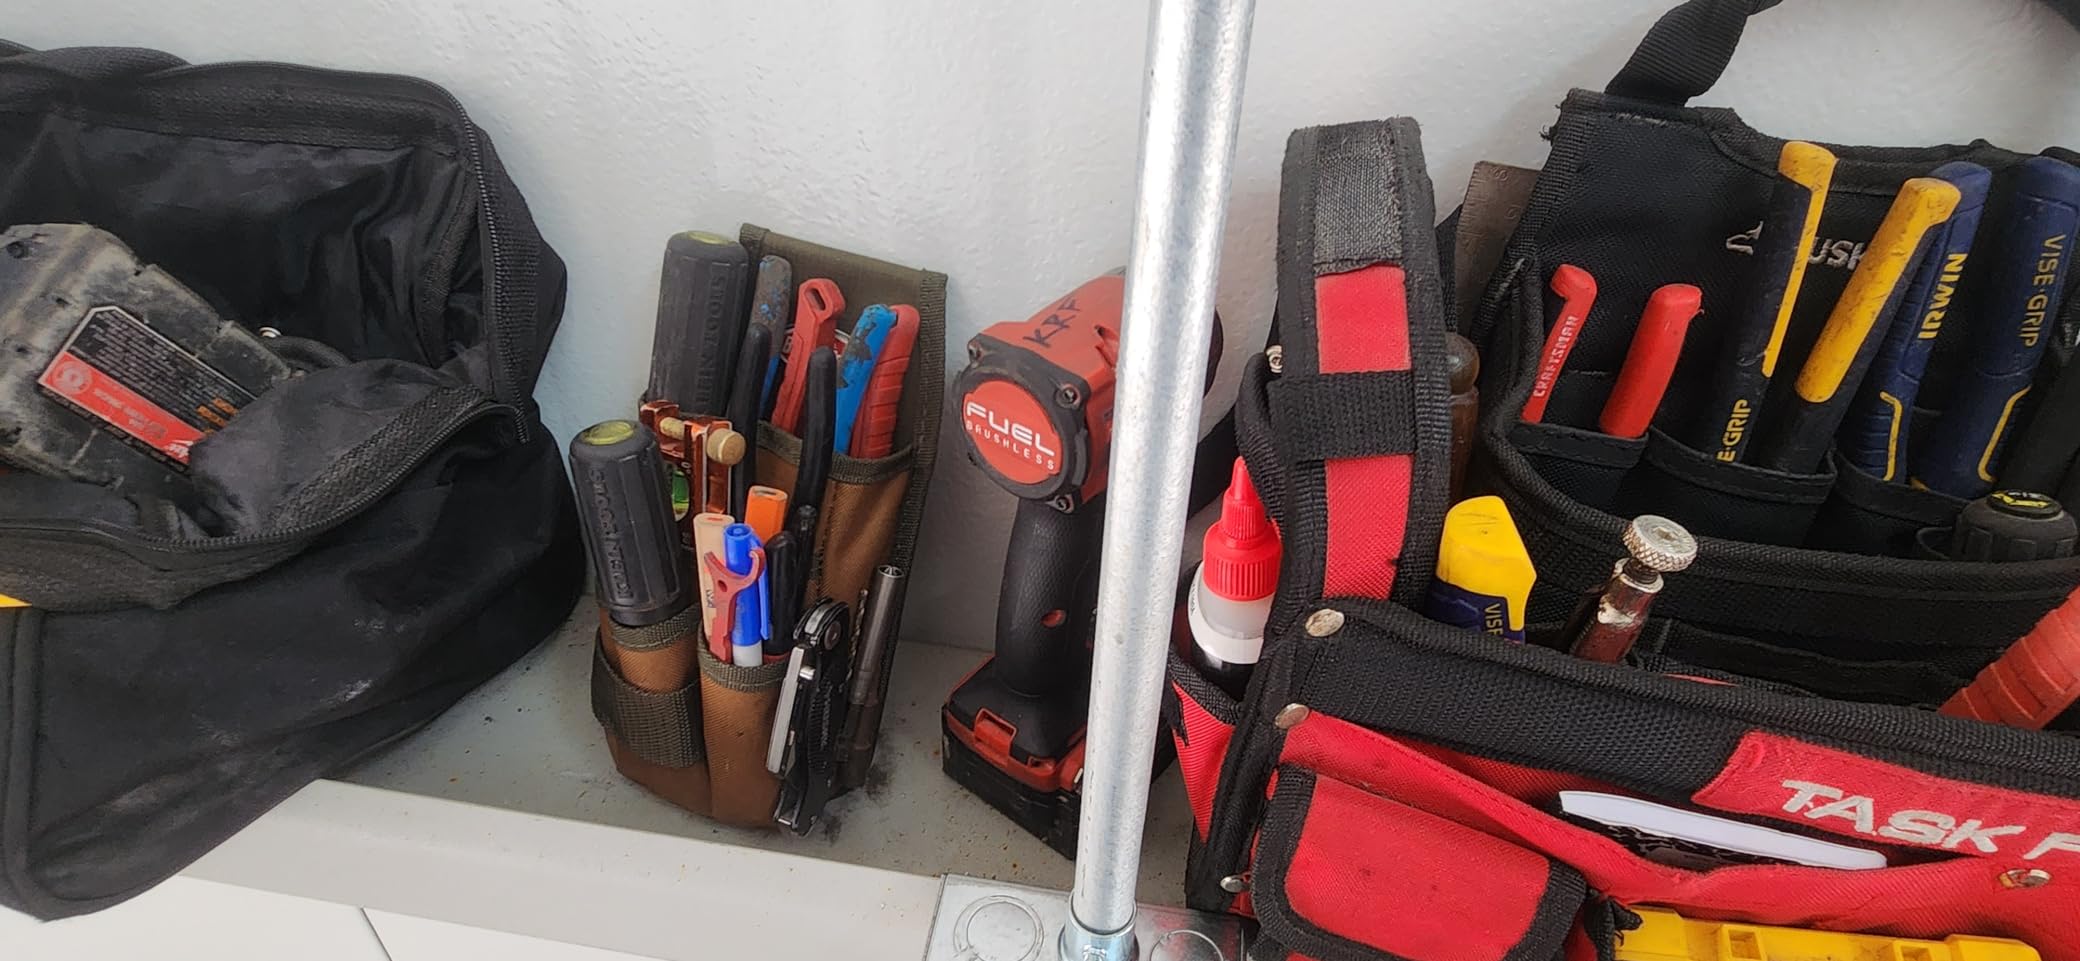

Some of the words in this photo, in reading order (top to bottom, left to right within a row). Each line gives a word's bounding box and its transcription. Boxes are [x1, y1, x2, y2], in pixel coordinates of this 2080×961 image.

[1917, 253, 1968, 339] IRWIN
[1533, 315, 1579, 397] CRAFTSMAN
[967, 402, 1055, 457] FUEL
[967, 420, 1055, 470] BRUSHLESS
[1782, 779, 2027, 853] TASK
[2023, 831, 2080, 861] F
